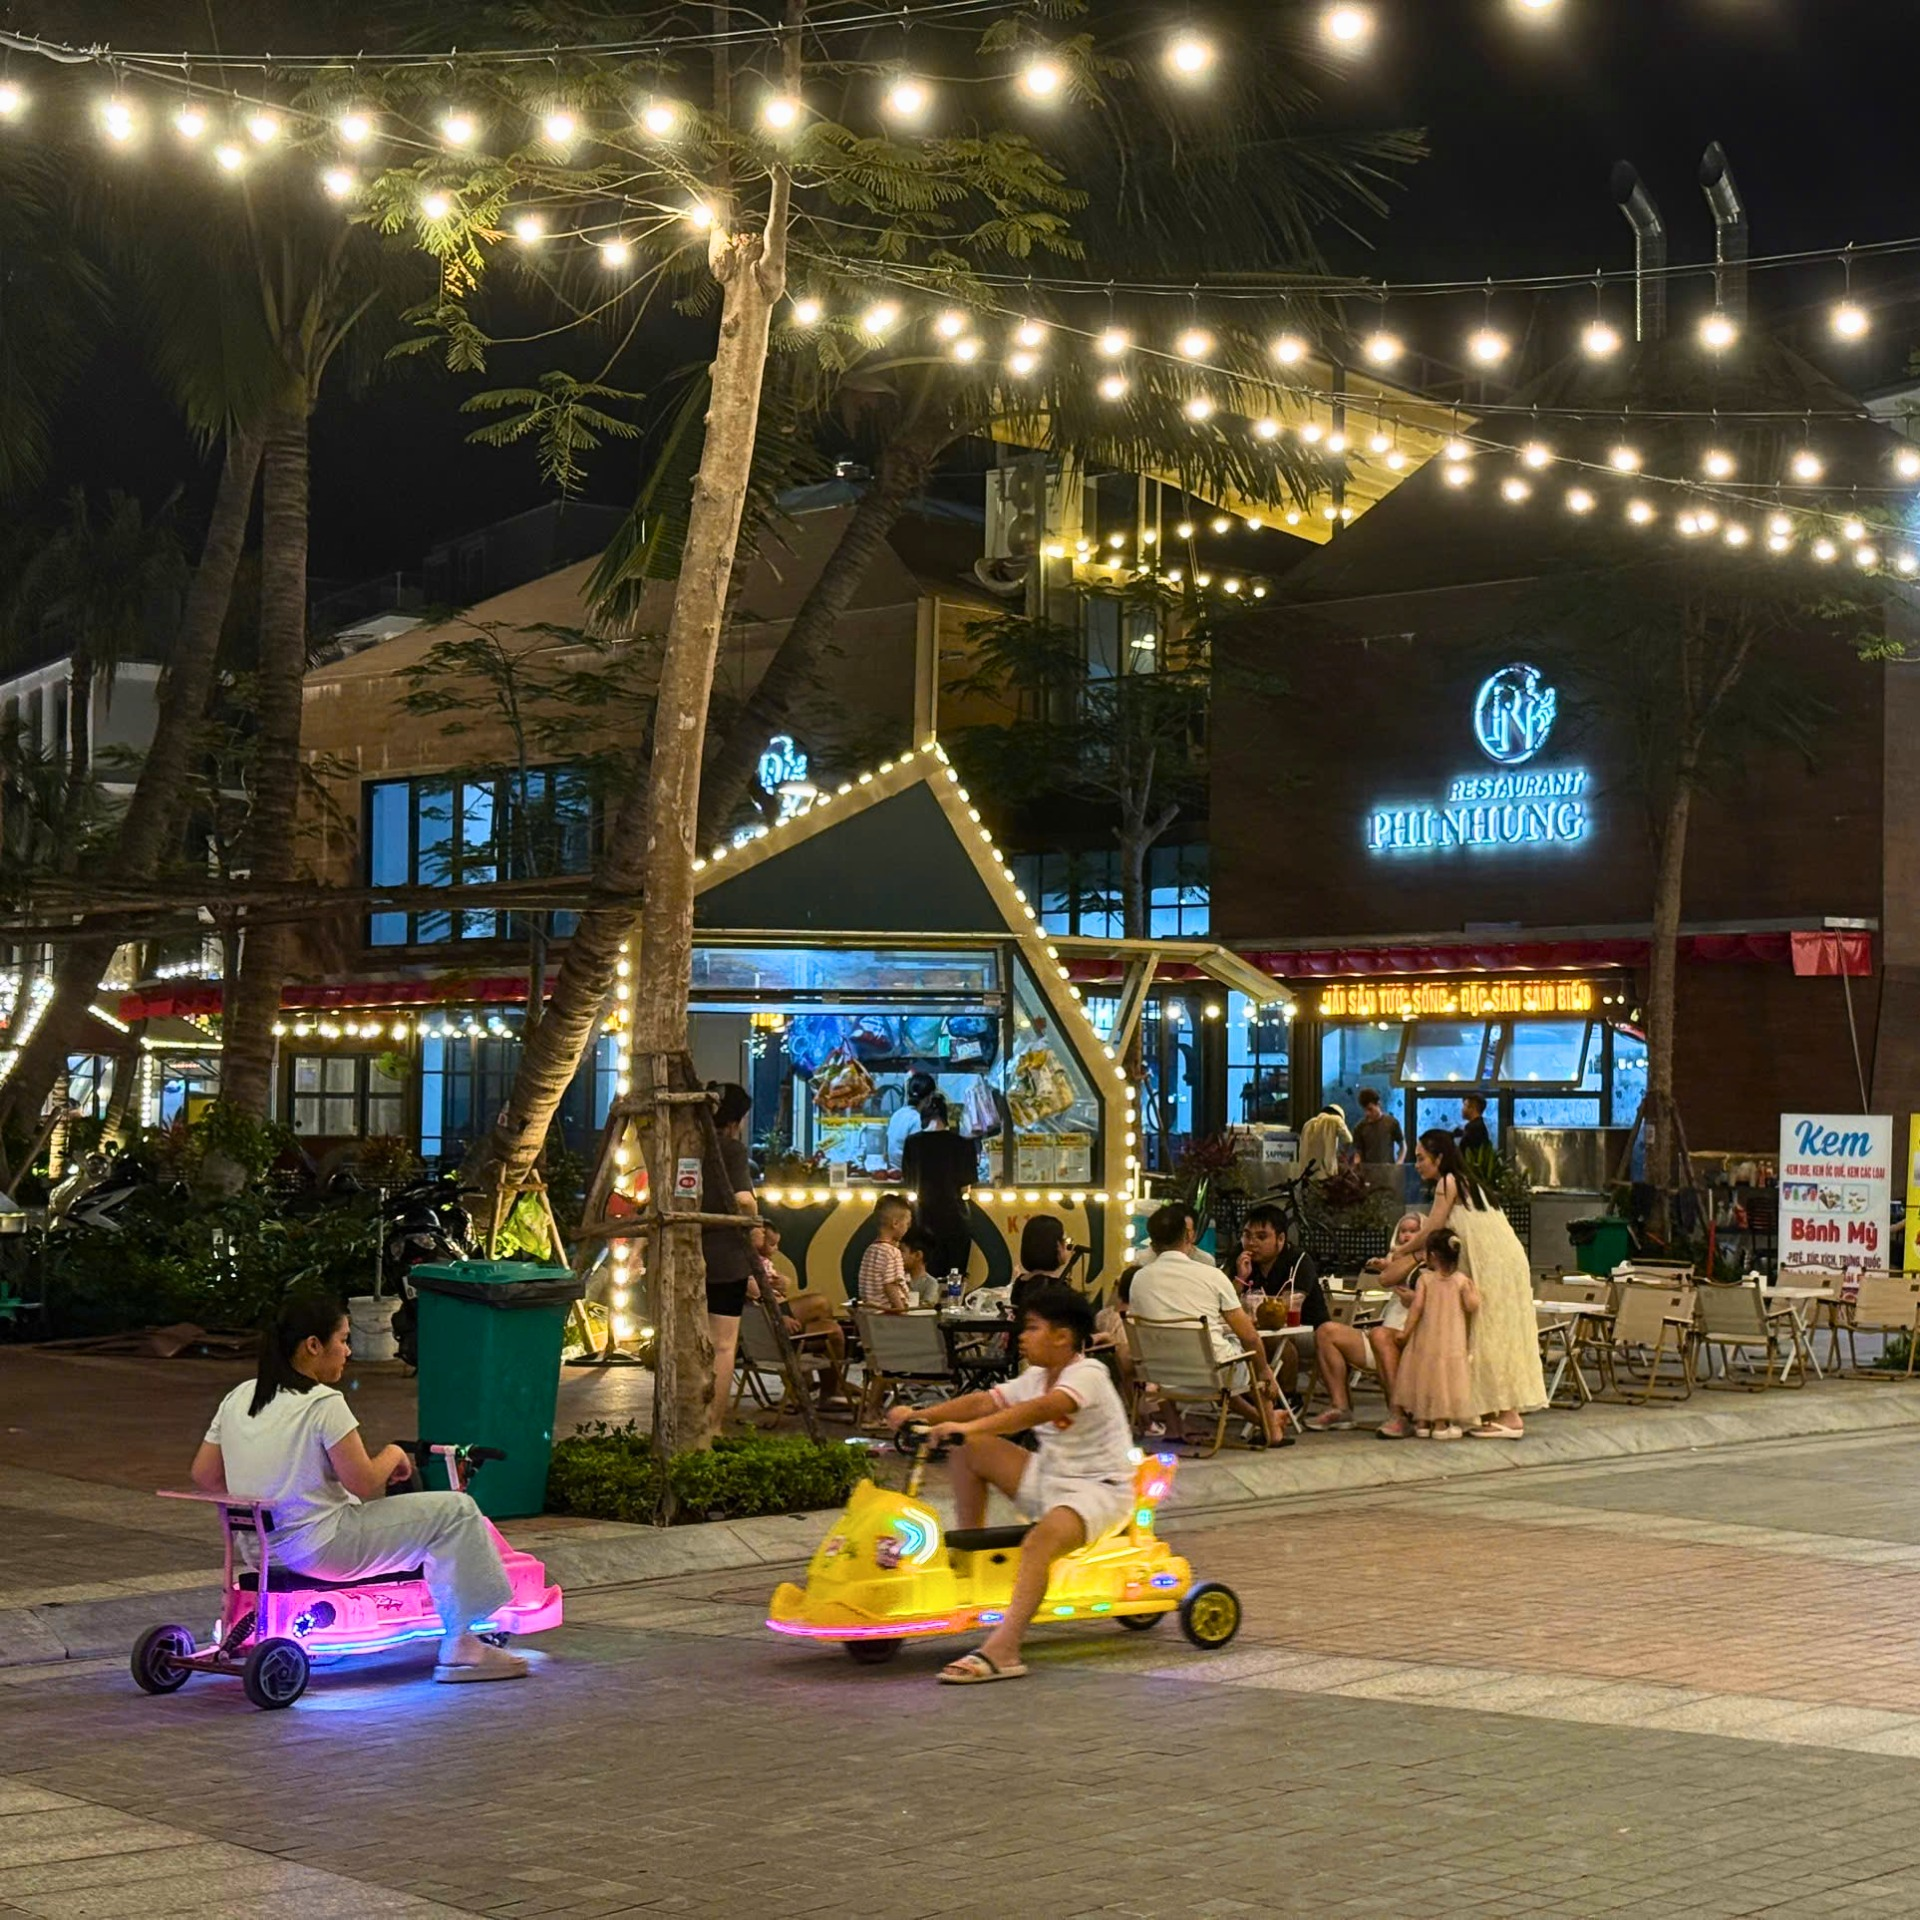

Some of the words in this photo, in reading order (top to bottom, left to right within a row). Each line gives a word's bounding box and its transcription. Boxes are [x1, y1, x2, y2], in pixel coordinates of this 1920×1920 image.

[1450, 772, 1586, 801] RESTAURANT
[1368, 809, 1436, 848] PHI
[1438, 802, 1584, 846] NHUNG
[1795, 1120, 1873, 1157] Kem
[1791, 1217, 1840, 1243] Bánh
